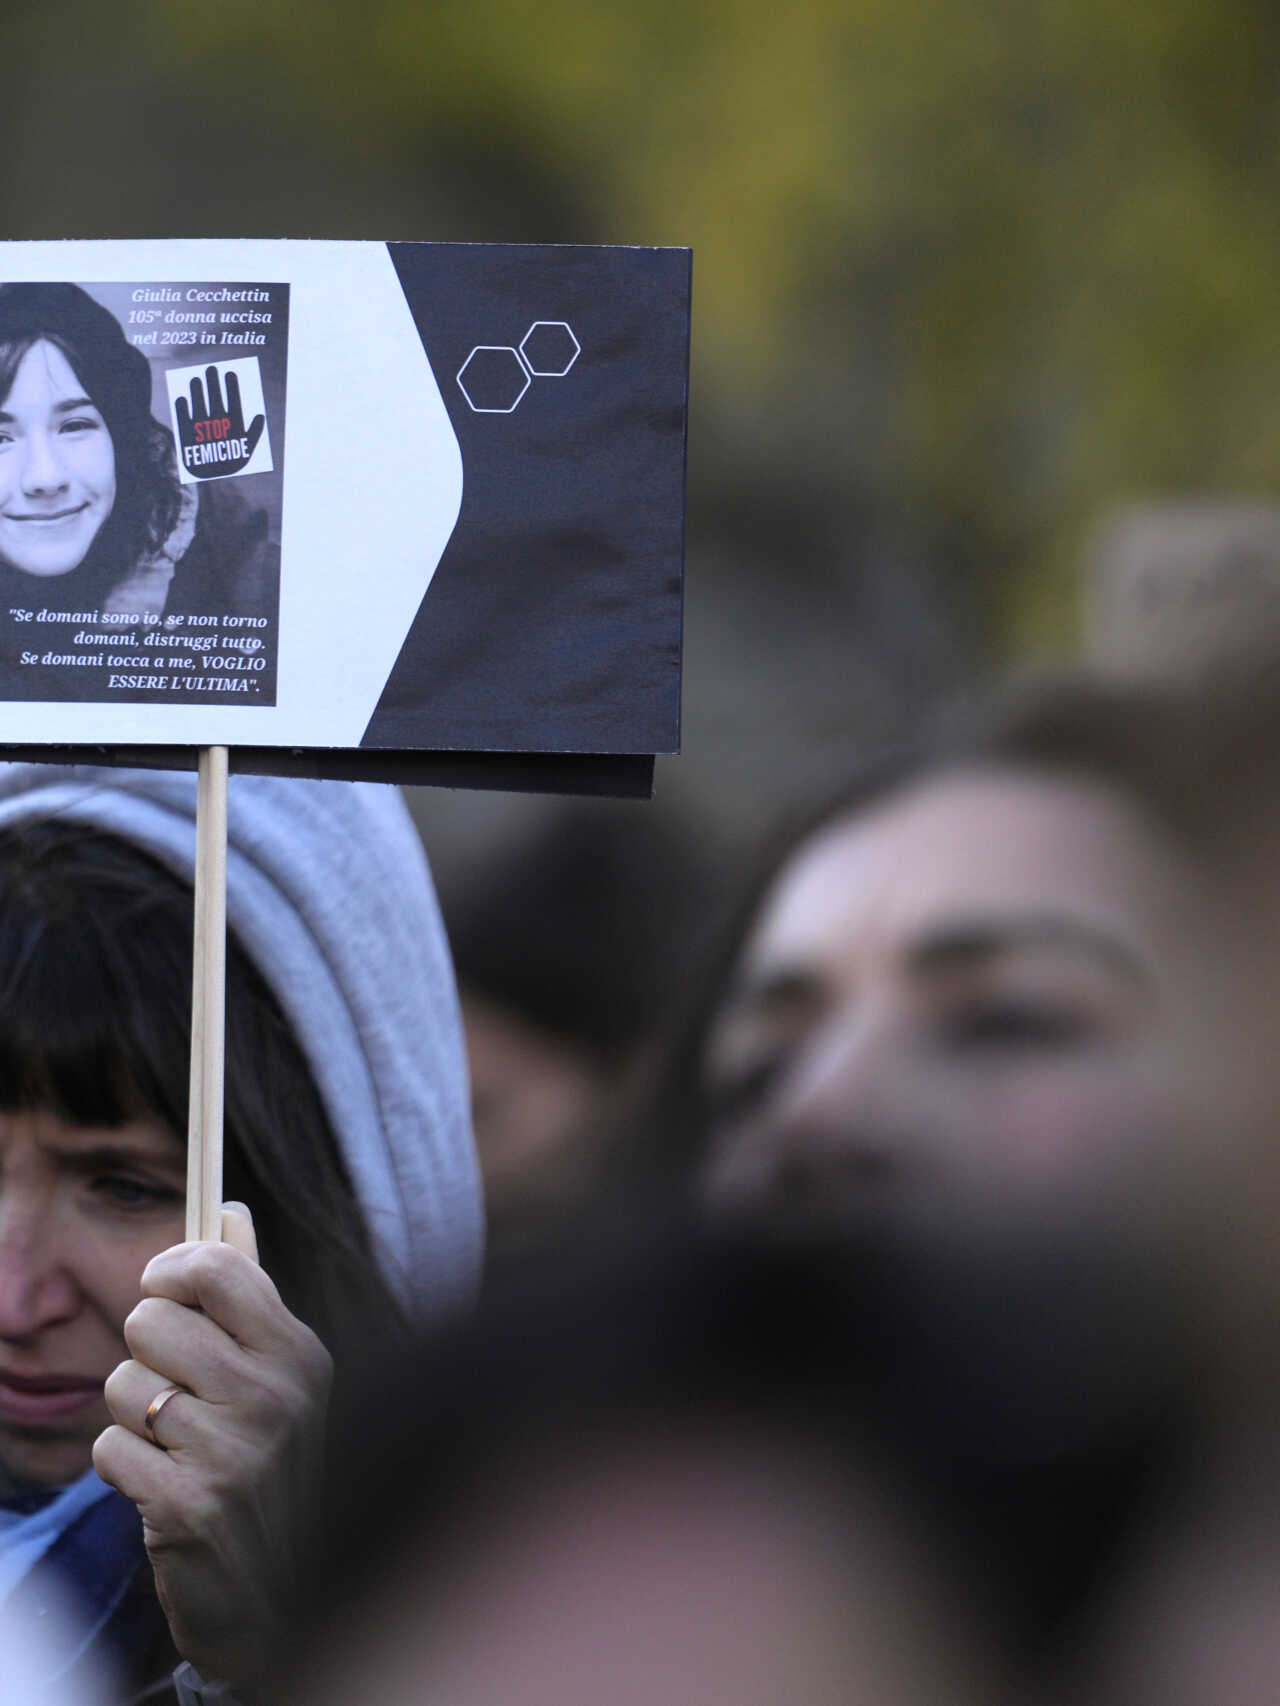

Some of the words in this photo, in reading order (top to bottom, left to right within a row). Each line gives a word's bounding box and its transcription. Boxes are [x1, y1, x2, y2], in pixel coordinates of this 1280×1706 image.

[132, 288, 181, 302] Giulia
[186, 288, 270, 302] Cecchettin
[165, 310, 216, 323] donna
[220, 310, 272, 323] uccisa
[133, 331, 157, 344] nel
[160, 332, 196, 344] 2023
[200, 332, 216, 344] in
[220, 332, 266, 345] Italia
[195, 418, 230, 442] STOP
[184, 438, 250, 466] FEMICIDE
[37, 609, 98, 623] domani
[102, 612, 139, 624] sono
[143, 610, 162, 626] io,
[166, 614, 184, 626] se
[188, 615, 218, 626] non
[222, 614, 267, 628] torno
[74, 631, 140, 647] domani,
[144, 632, 218, 650] distruggi
[222, 636, 265, 649] tutto.
[21, 652, 38, 665] Se
[42, 652, 103, 666] domani
[107, 655, 149, 667] tocca
[154, 657, 164, 668] a
[169, 657, 196, 670] me,
[202, 656, 266, 670] VOGLIO
[108, 675, 167, 688] ESSERE
